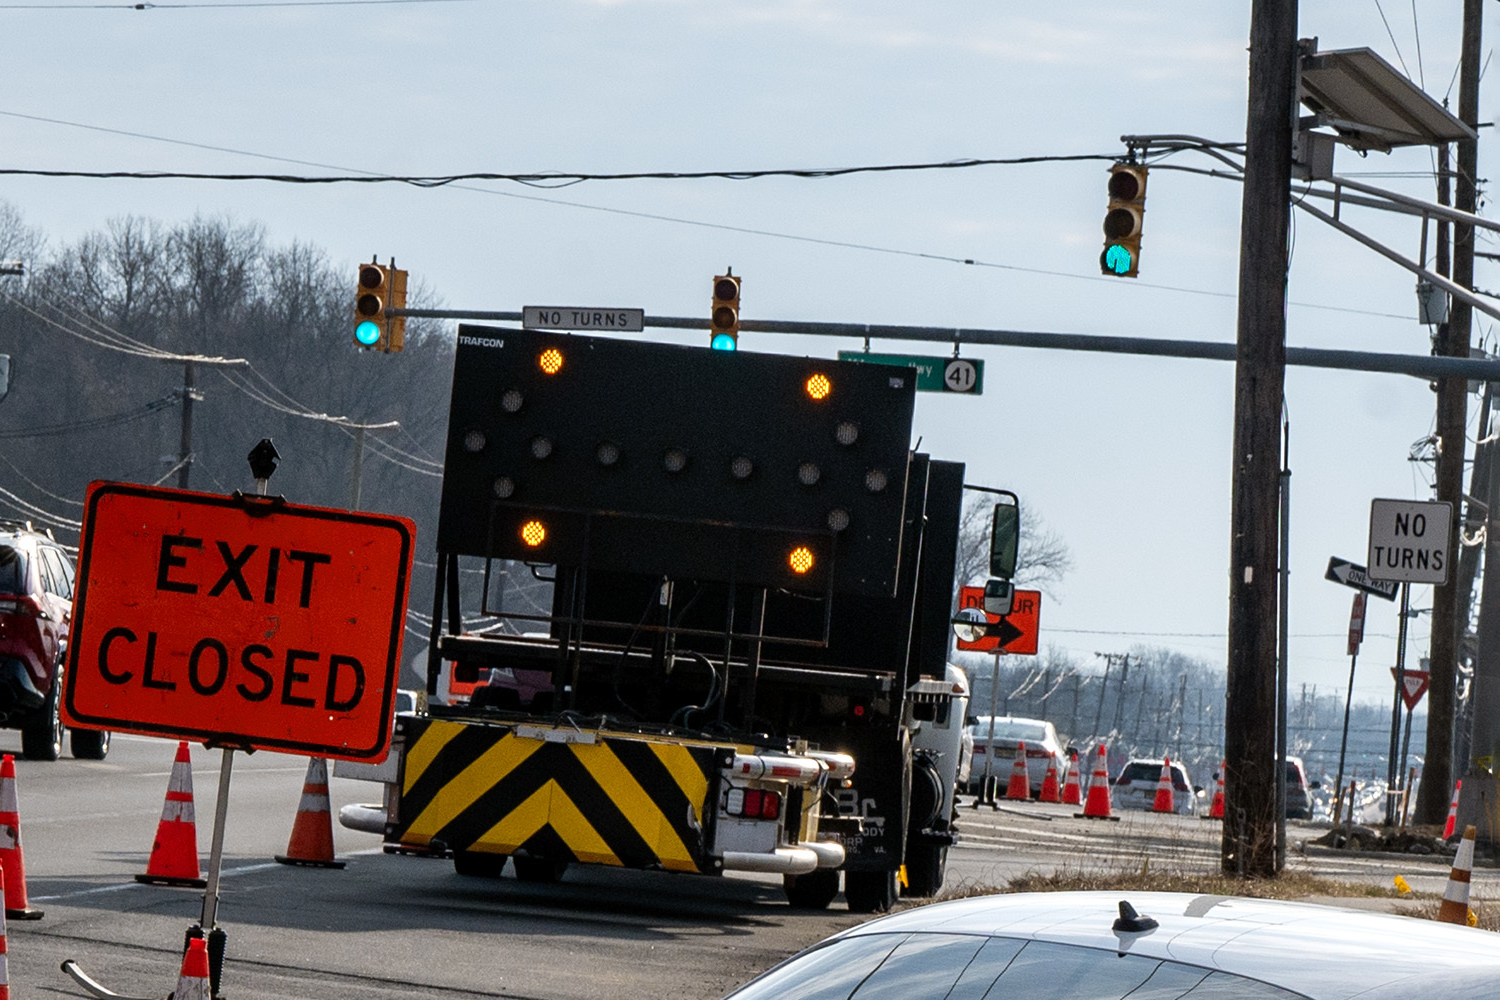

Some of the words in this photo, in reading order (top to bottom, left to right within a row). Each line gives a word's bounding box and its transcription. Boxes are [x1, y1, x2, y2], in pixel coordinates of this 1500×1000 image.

[538, 311, 561, 325] NO
[572, 312, 628, 327] TURNS
[458, 335, 504, 348] TRAFCON
[948, 366, 970, 386] 41
[1394, 512, 1426, 537] NO
[1374, 546, 1443, 571] TURNS
[156, 534, 332, 608] EXIT
[966, 595, 1034, 615] DEUR
[97, 627, 366, 712] CLOSED
[855, 827, 885, 837] ODY
